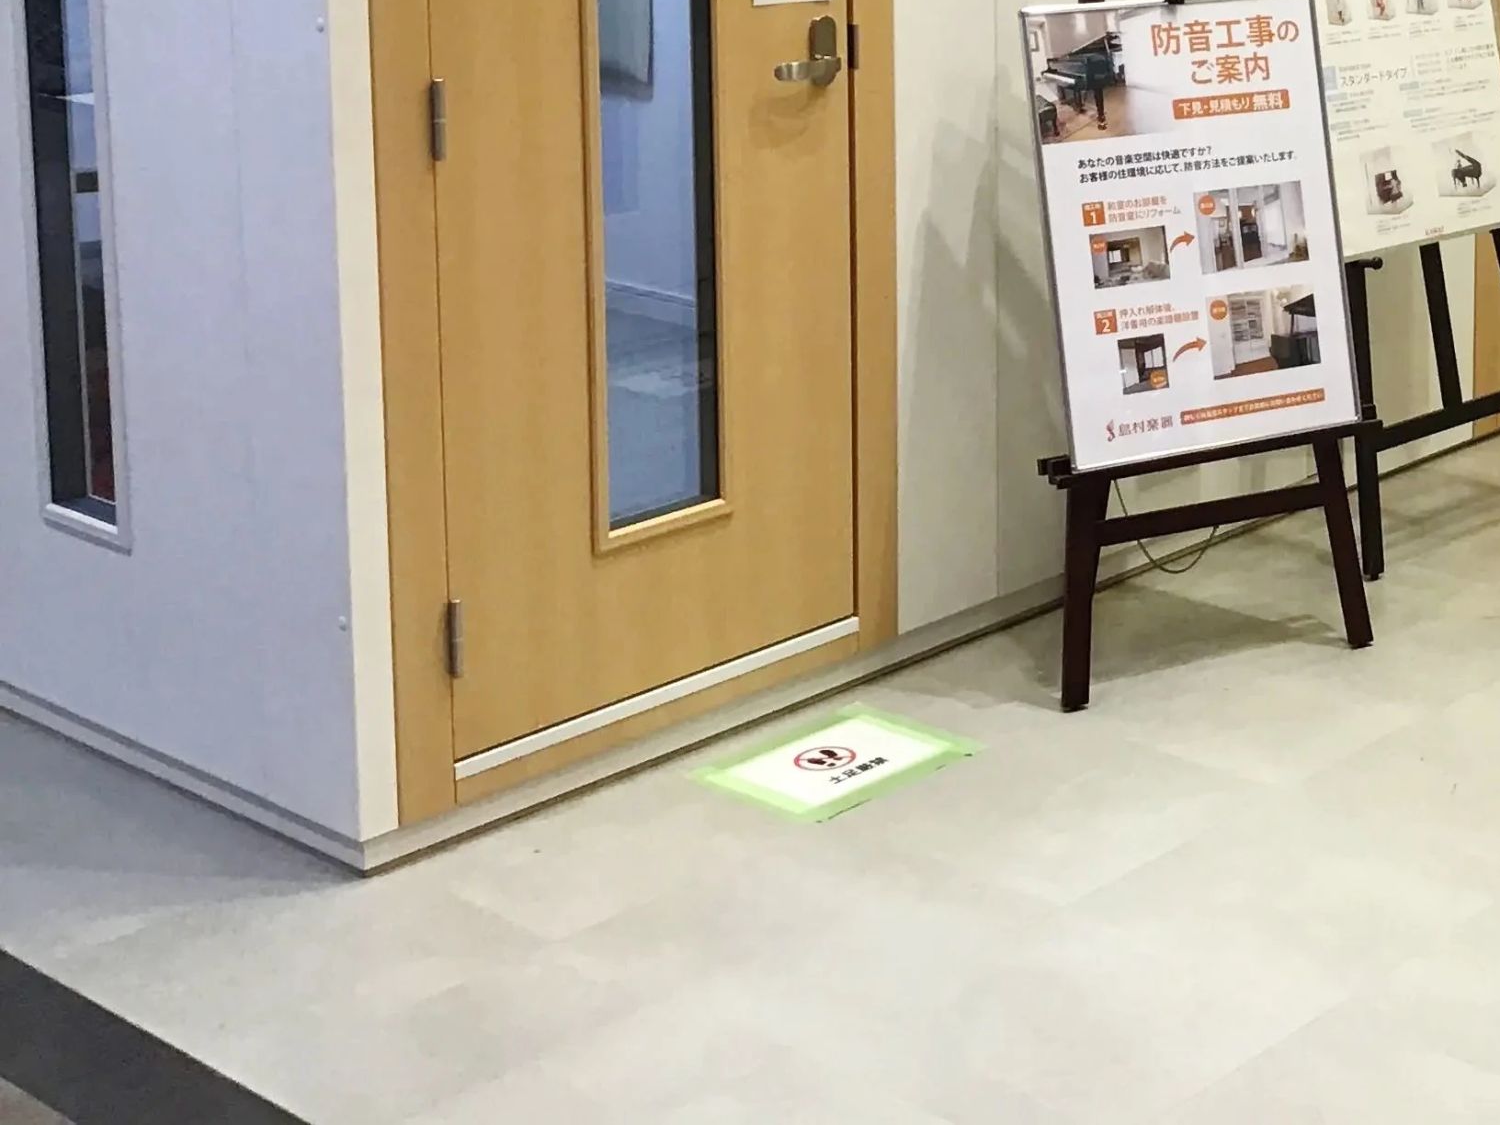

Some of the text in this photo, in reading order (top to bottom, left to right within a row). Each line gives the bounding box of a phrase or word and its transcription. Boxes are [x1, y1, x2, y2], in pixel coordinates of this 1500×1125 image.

[1150, 14, 1299, 57] 防音工事の
[1191, 52, 1270, 85] ご案内
[1089, 210, 1098, 225] 1
[1102, 320, 1111, 333] 2
